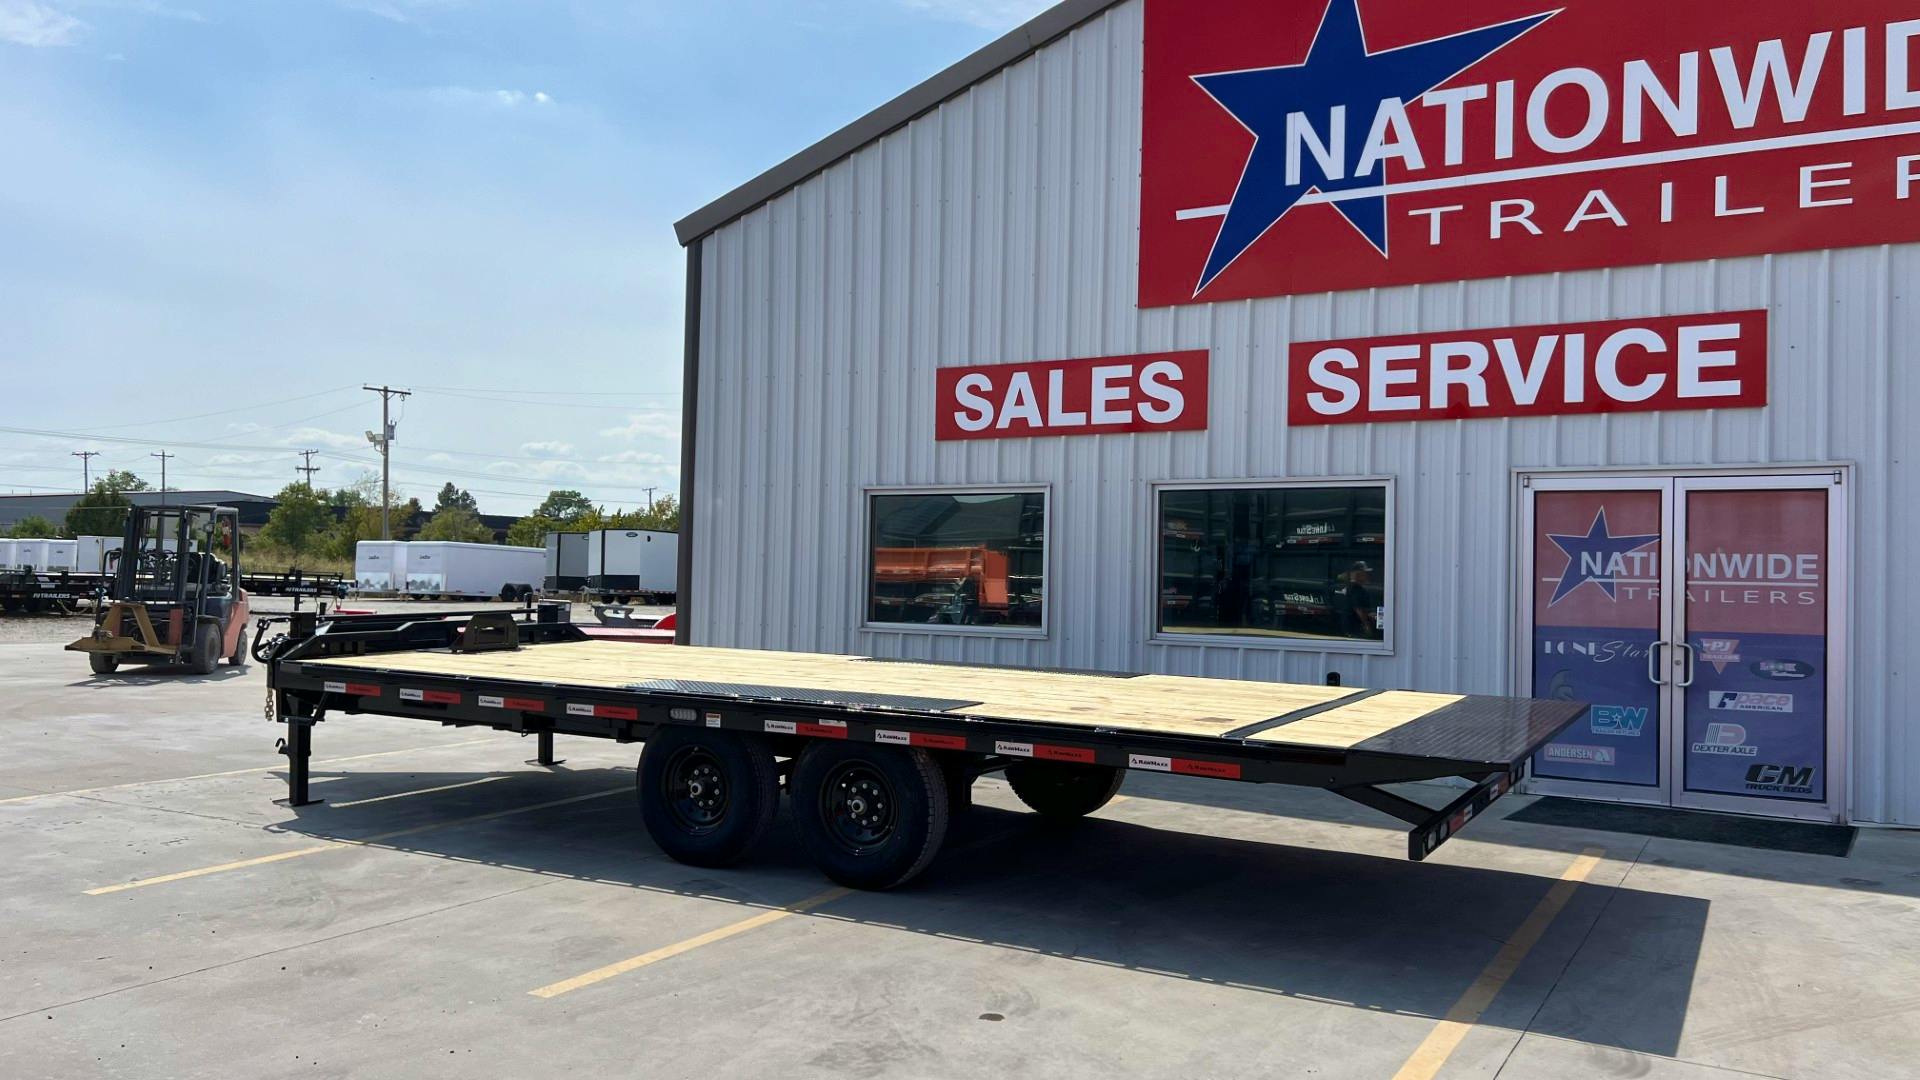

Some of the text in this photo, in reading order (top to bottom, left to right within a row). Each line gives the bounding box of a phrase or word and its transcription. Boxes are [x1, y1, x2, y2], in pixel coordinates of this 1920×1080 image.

[1307, 323, 1741, 415] SERVICE
[954, 361, 1184, 432] SALES
[1580, 551, 1819, 580] NATINWIDE
[1693, 744, 1730, 754] DEXTER
